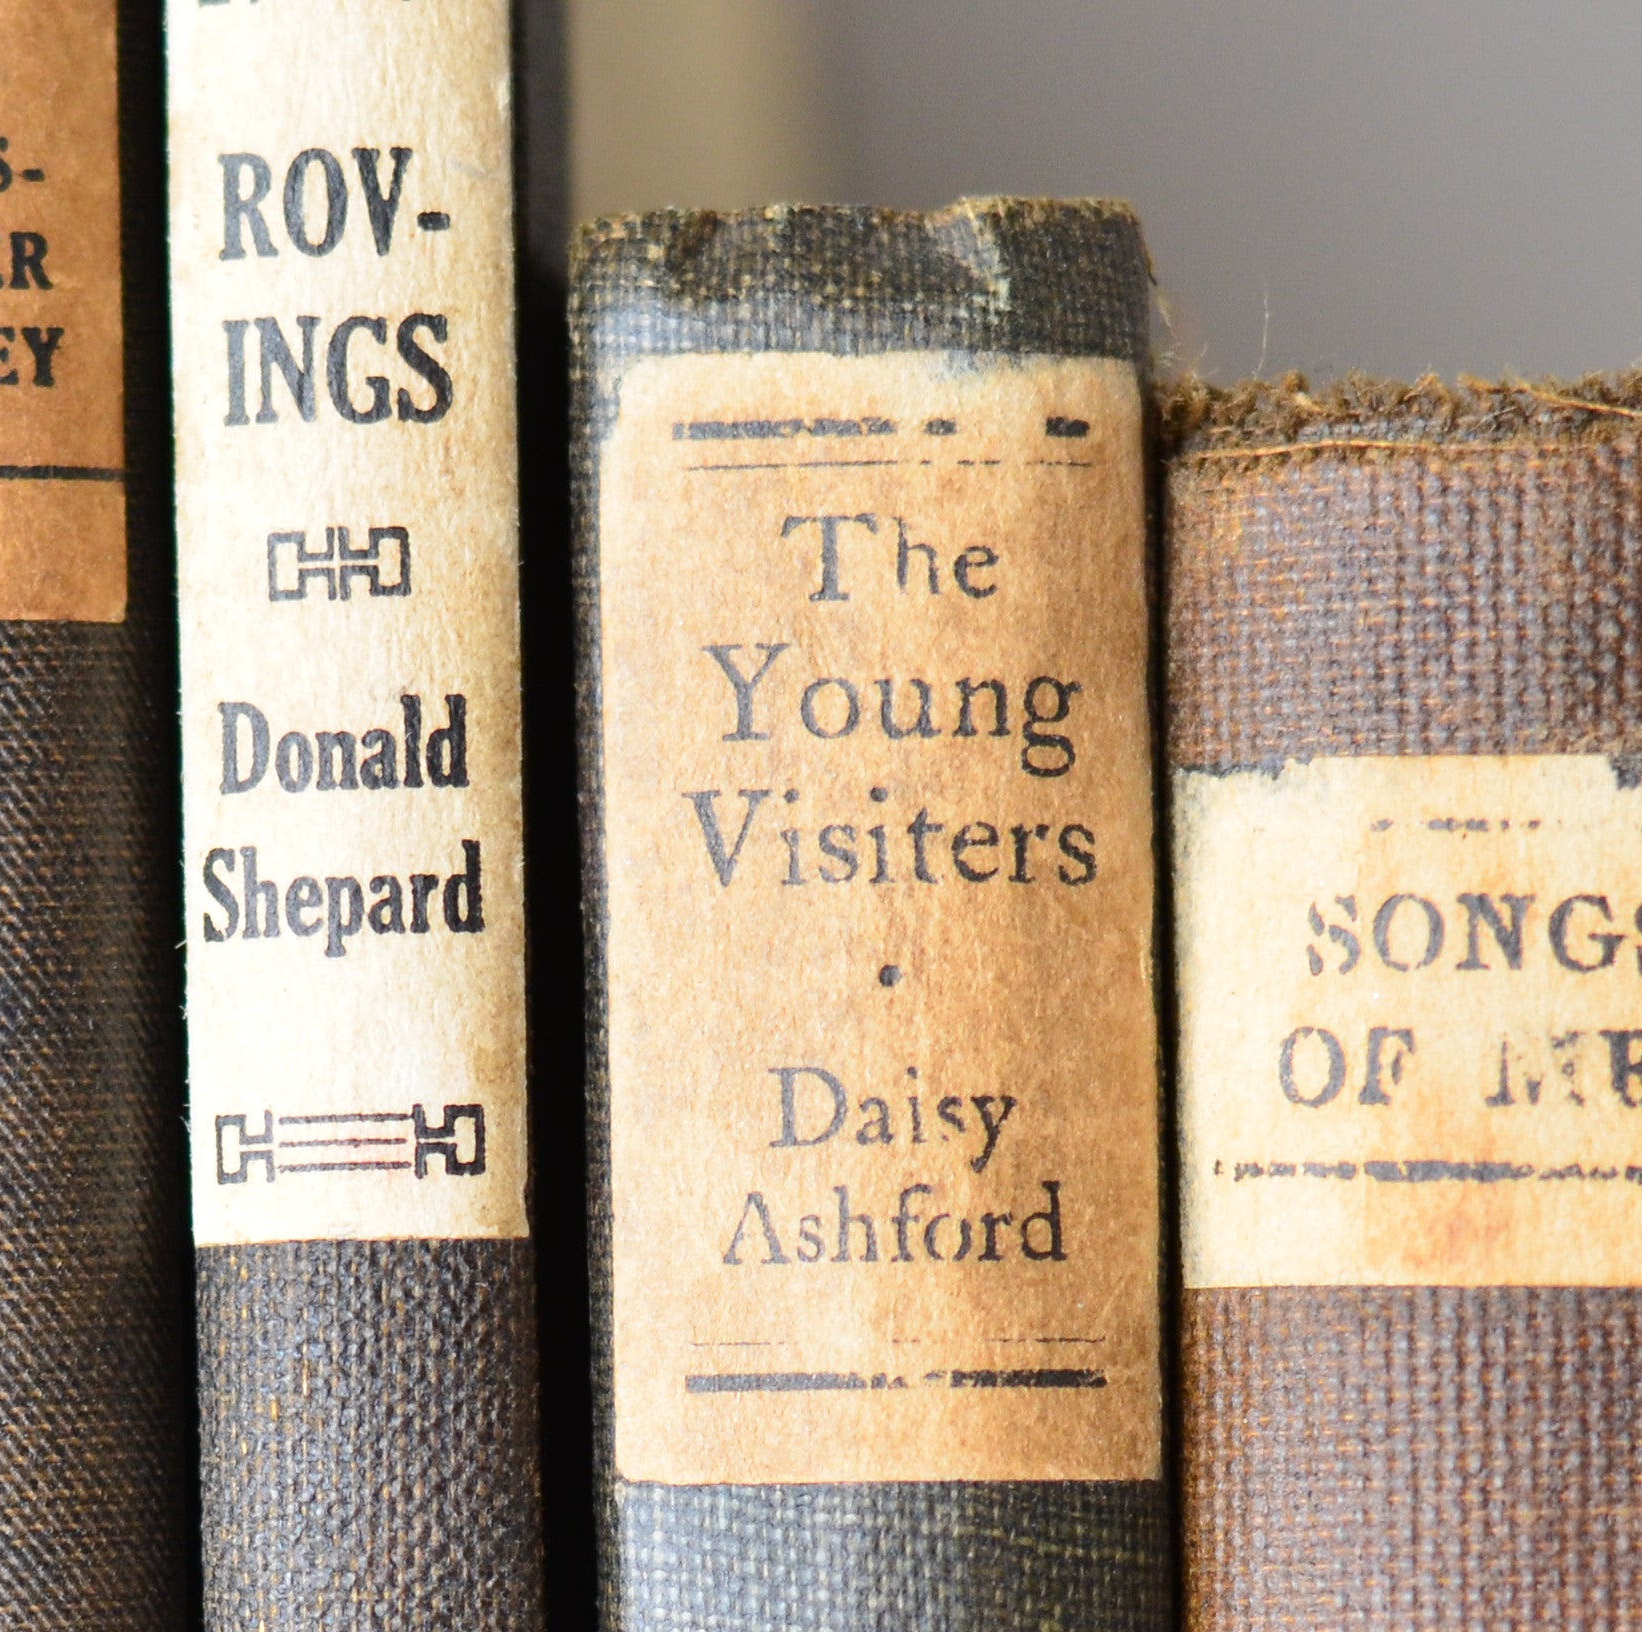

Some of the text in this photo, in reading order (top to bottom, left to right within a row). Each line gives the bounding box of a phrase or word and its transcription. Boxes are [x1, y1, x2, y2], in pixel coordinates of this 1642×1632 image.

[218, 146, 452, 262] ROV-
[221, 312, 454, 427] INGS
[780, 512, 1000, 603] The
[218, 693, 471, 797] Donald
[701, 641, 1083, 779] Young
[680, 785, 1099, 888] Visiters
[202, 838, 486, 958] Shepard
[767, 1066, 1017, 1174] Daisy
[1277, 1025, 1418, 1110] OF
[722, 1181, 1069, 1266] Ashford
